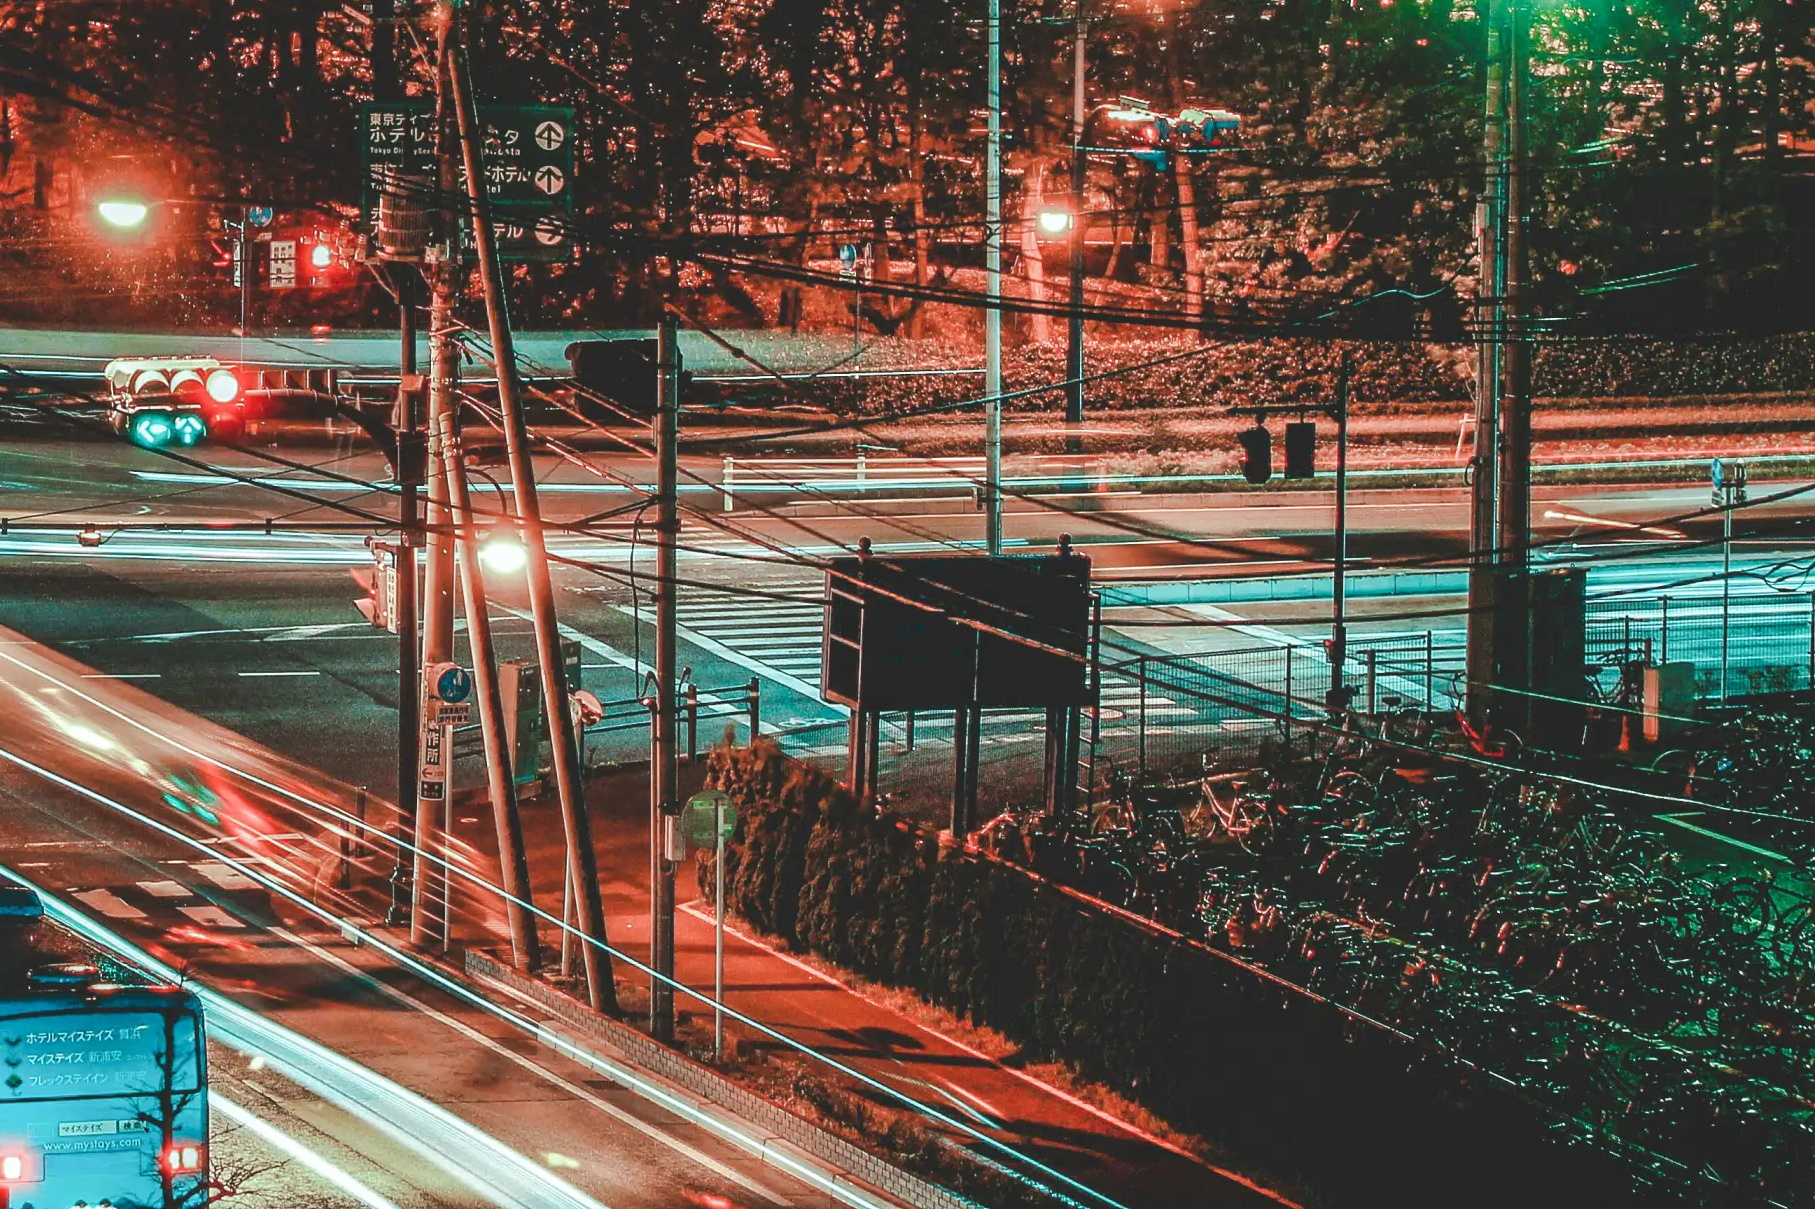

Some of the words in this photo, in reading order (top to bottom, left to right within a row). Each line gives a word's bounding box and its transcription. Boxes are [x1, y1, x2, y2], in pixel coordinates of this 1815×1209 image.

[26, 1029, 114, 1044] ホテルマイステイズ
[27, 1051, 84, 1065] マイステイズ
[62, 1123, 103, 1134] マイステイズ
[44, 1138, 141, 1152] www.mystays.com
